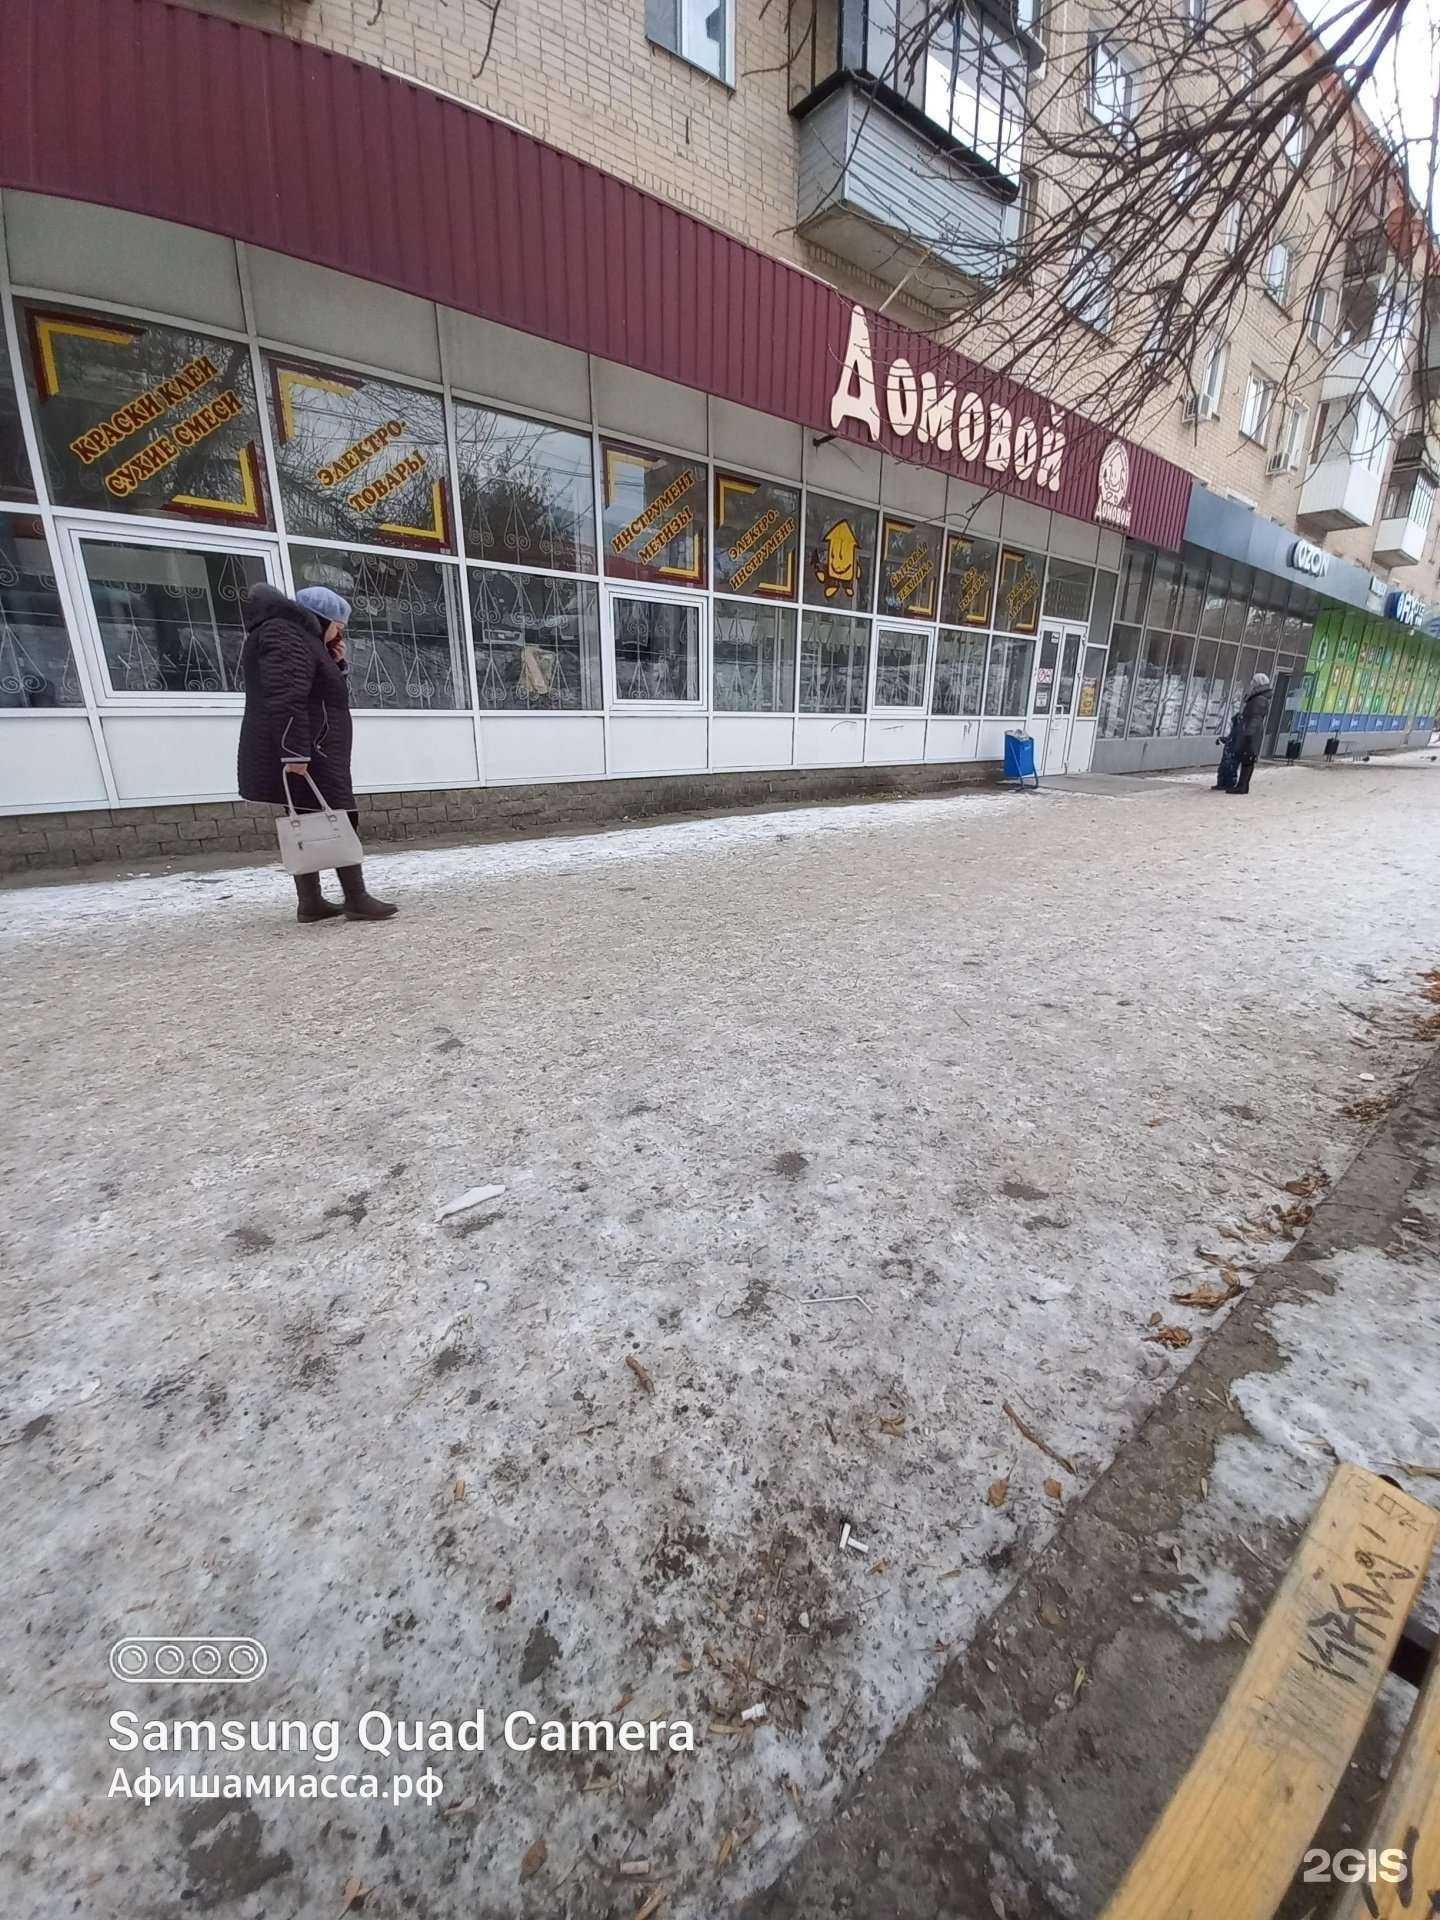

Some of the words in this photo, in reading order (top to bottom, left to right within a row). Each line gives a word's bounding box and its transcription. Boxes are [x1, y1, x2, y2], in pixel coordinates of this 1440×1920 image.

[70, 392, 165, 464] КРАСКИ
[105, 436, 180, 496] СУХИЕ
[173, 390, 243, 447] СМЕСИ
[348, 449, 427, 513] ТОВАРЫ
[611, 469, 695, 554] ИНСТРУМЕНТ
[638, 505, 693, 565] МЕТИЗЫ
[729, 517, 795, 591] ИНСТРУМЕНТ
